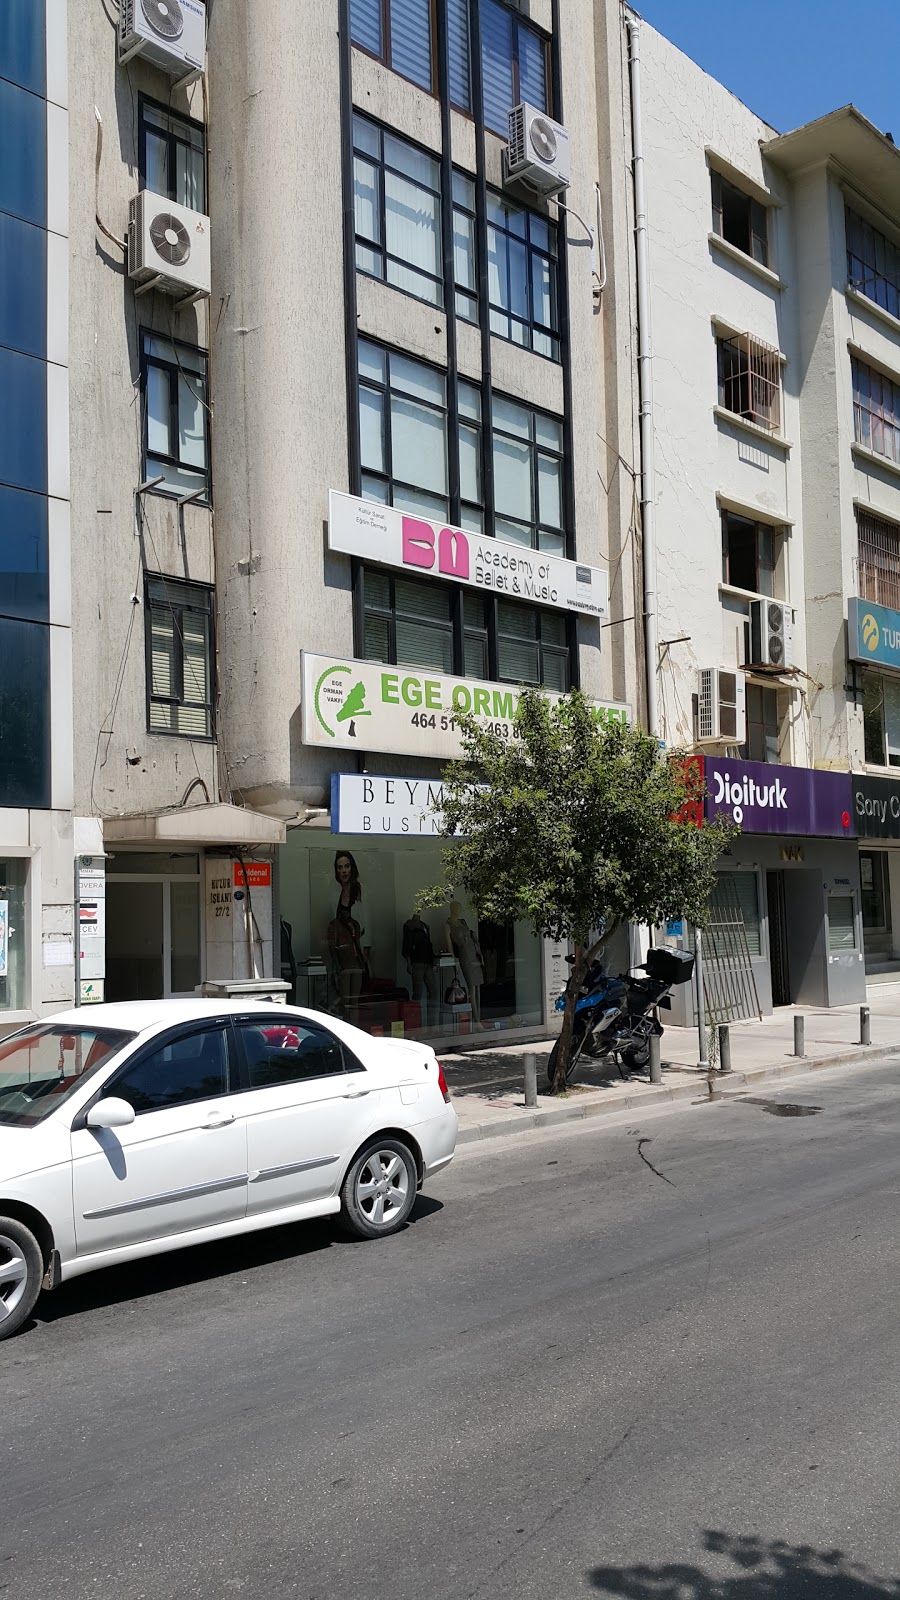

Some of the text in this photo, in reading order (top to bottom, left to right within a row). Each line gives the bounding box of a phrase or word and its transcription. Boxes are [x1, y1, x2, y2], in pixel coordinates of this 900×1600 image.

[475, 545, 551, 579] Academy of
[475, 566, 509, 590] Ballet
[511, 578, 521, 592] &
[523, 579, 558, 603] Music
[323, 687, 343, 696] ORMAN
[380, 672, 442, 711] EGE
[451, 684, 550, 726] ORM
[411, 712, 436, 730] 464
[440, 714, 455, 732] 51
[489, 721, 509, 739] 463
[855, 791, 887, 823] Sony
[215, 906, 230, 917] 27/2
